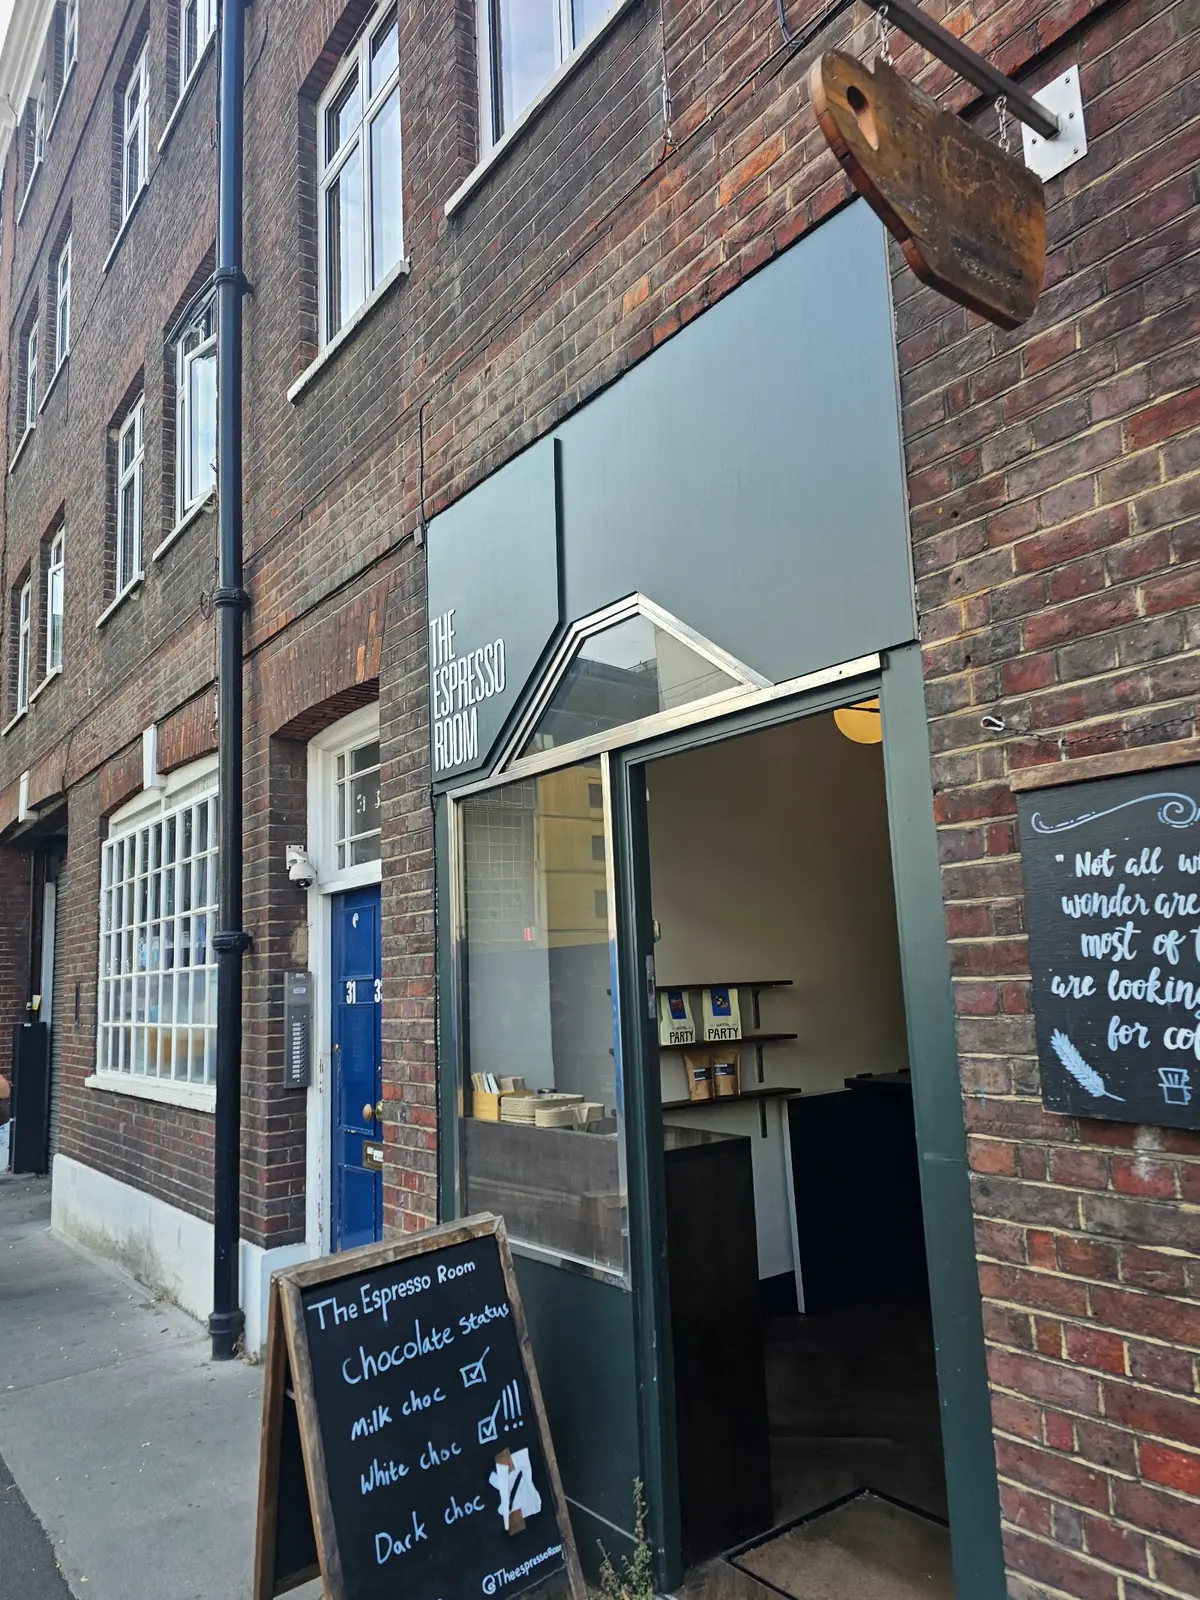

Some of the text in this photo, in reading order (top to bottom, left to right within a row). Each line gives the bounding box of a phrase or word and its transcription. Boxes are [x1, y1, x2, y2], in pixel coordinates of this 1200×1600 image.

[430, 609, 456, 668] THE
[433, 638, 506, 720] ESPRESSO
[434, 706, 479, 772] ROOM
[1075, 849, 1117, 878] Not
[1124, 846, 1164, 876] all
[1154, 891, 1200, 918] are
[1081, 920, 1141, 962] most
[1153, 929, 1187, 965] of
[346, 978, 383, 1004] 31 3
[1051, 974, 1097, 999] are
[669, 1030, 694, 1044] PARTY
[707, 1027, 739, 1040] PARTY
[1107, 1015, 1151, 1051] for
[308, 1260, 476, 1330] The Espresso Room
[342, 1319, 455, 1386] Chocolate
[402, 1387, 447, 1416] choc
[360, 1441, 462, 1496] White choc
[374, 1495, 486, 1565] Dark choc
